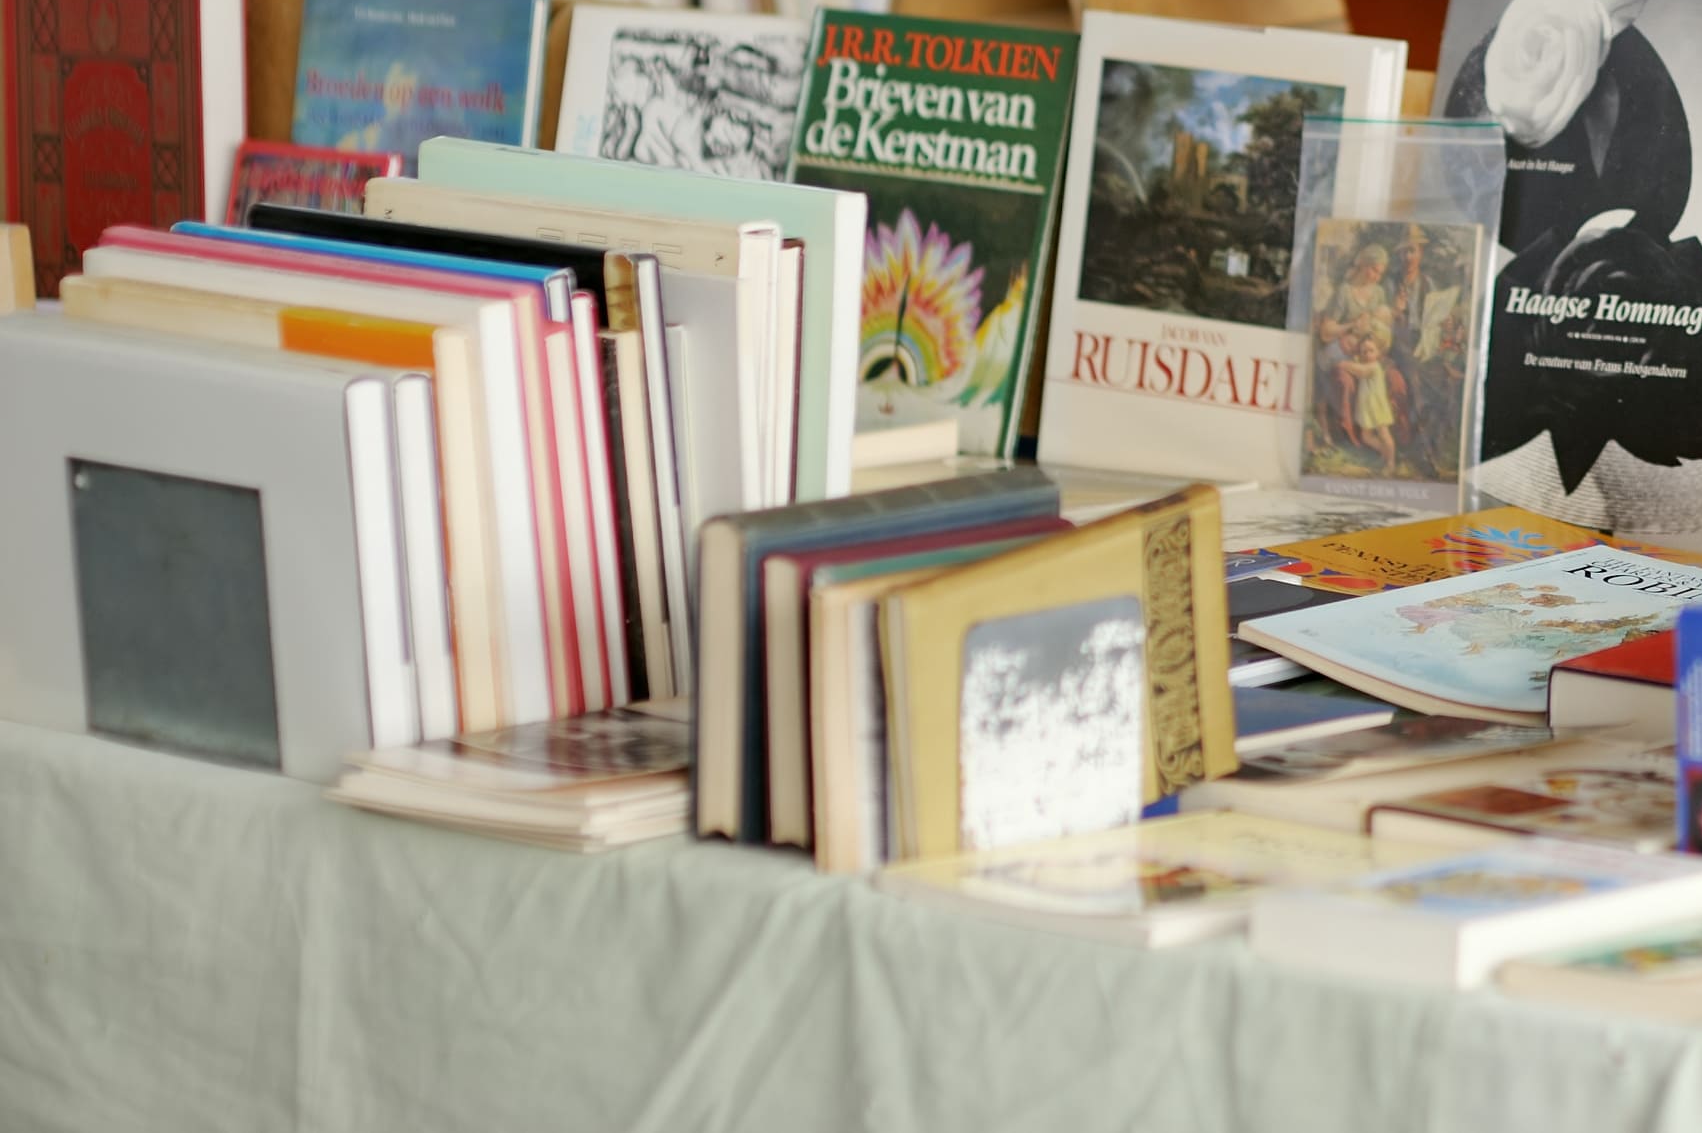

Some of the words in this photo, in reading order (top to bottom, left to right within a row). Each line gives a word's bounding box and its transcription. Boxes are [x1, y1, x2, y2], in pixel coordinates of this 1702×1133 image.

[816, 23, 901, 66] J.R.R.
[905, 31, 1063, 82] TOLKIEN
[822, 57, 967, 122] Brieven
[966, 88, 1037, 130] van
[805, 106, 854, 158] de
[852, 112, 1037, 179] Kerstman
[1506, 286, 1591, 325] Haagse
[1523, 352, 1538, 366] De
[1538, 355, 1573, 370] couture
[1573, 358, 1593, 371] van
[1594, 358, 1623, 374] Frans
[1623, 361, 1688, 379] Hoogendoorn
